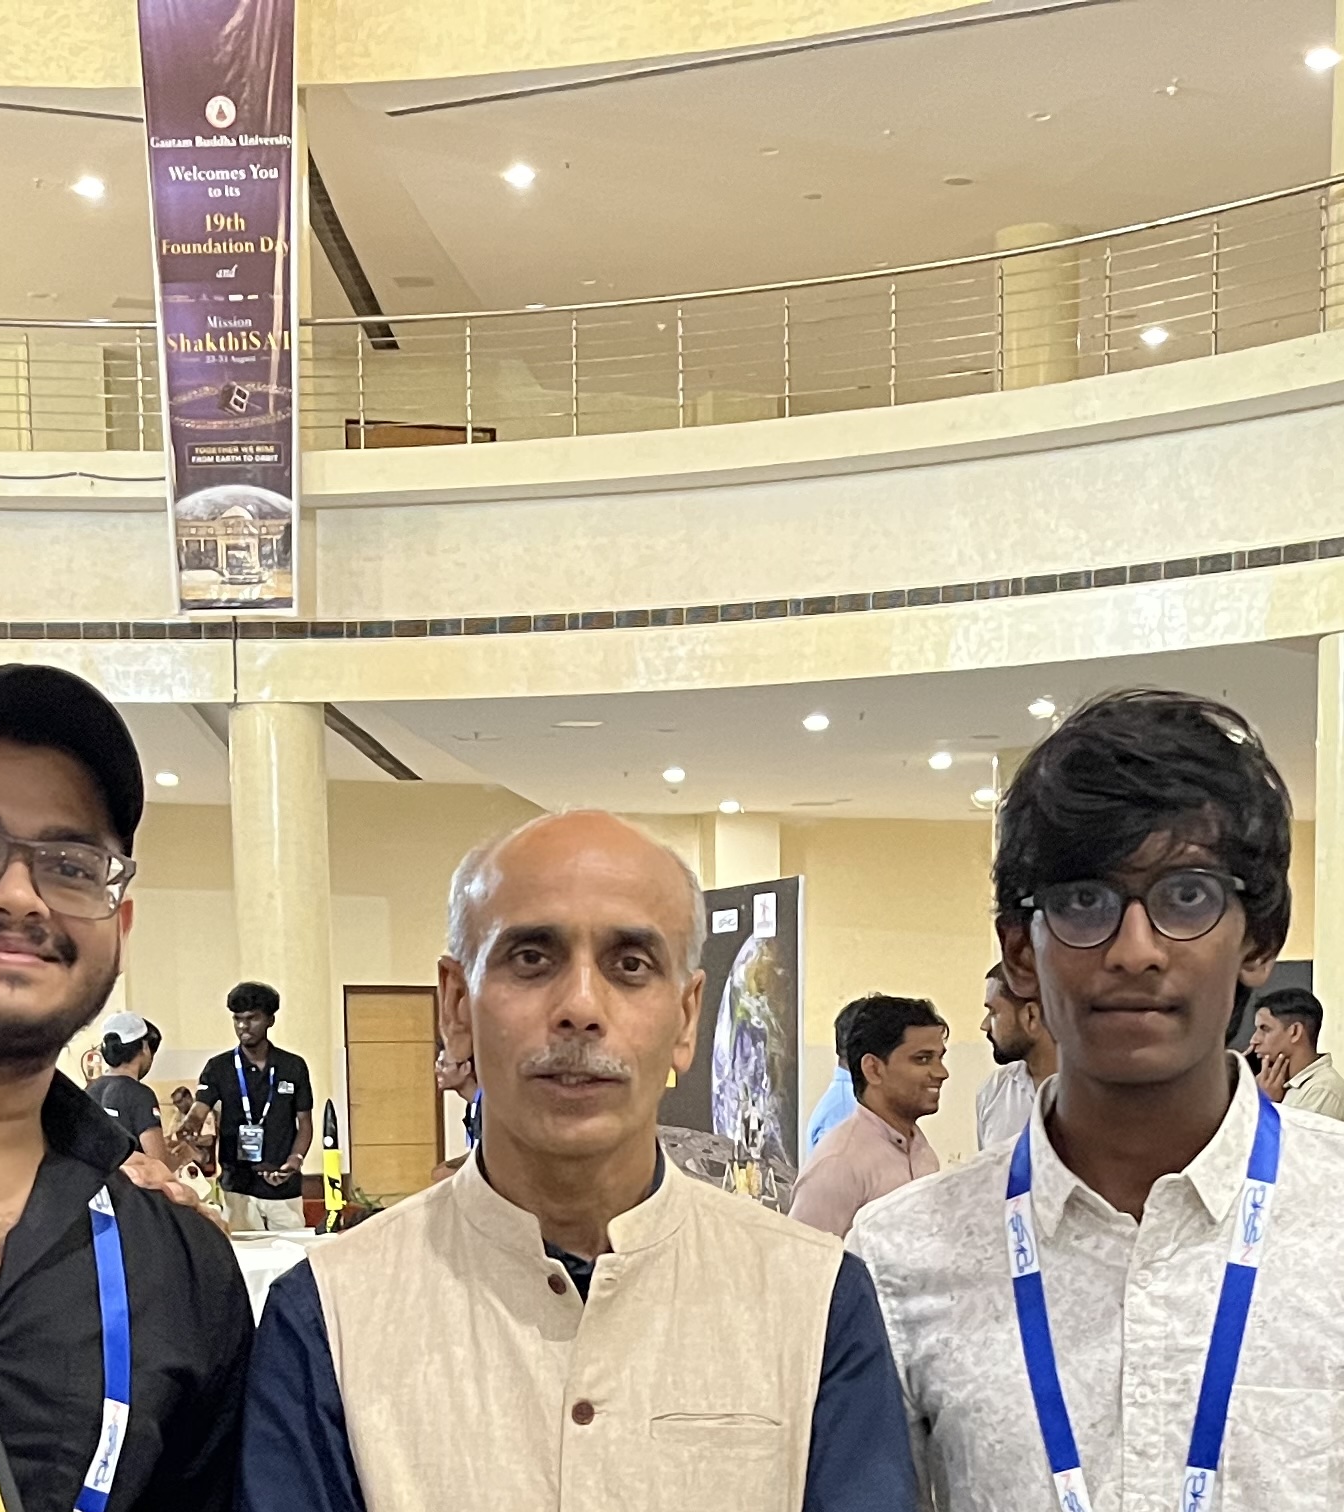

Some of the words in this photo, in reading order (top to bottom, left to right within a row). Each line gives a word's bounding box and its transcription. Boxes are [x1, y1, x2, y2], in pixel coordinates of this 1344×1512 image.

[150, 136, 193, 148] Gautam
[195, 135, 237, 147] Buddha
[238, 134, 292, 148] University
[168, 165, 246, 181] Welcomes
[249, 163, 279, 179] You
[208, 186, 222, 198] to
[206, 213, 245, 233] 19th
[162, 239, 254, 256] Foundation
[216, 265, 237, 279] and
[207, 316, 252, 328] Mission
[216, 455, 241, 463] EARTH
[255, 454, 278, 462] ORBIT
